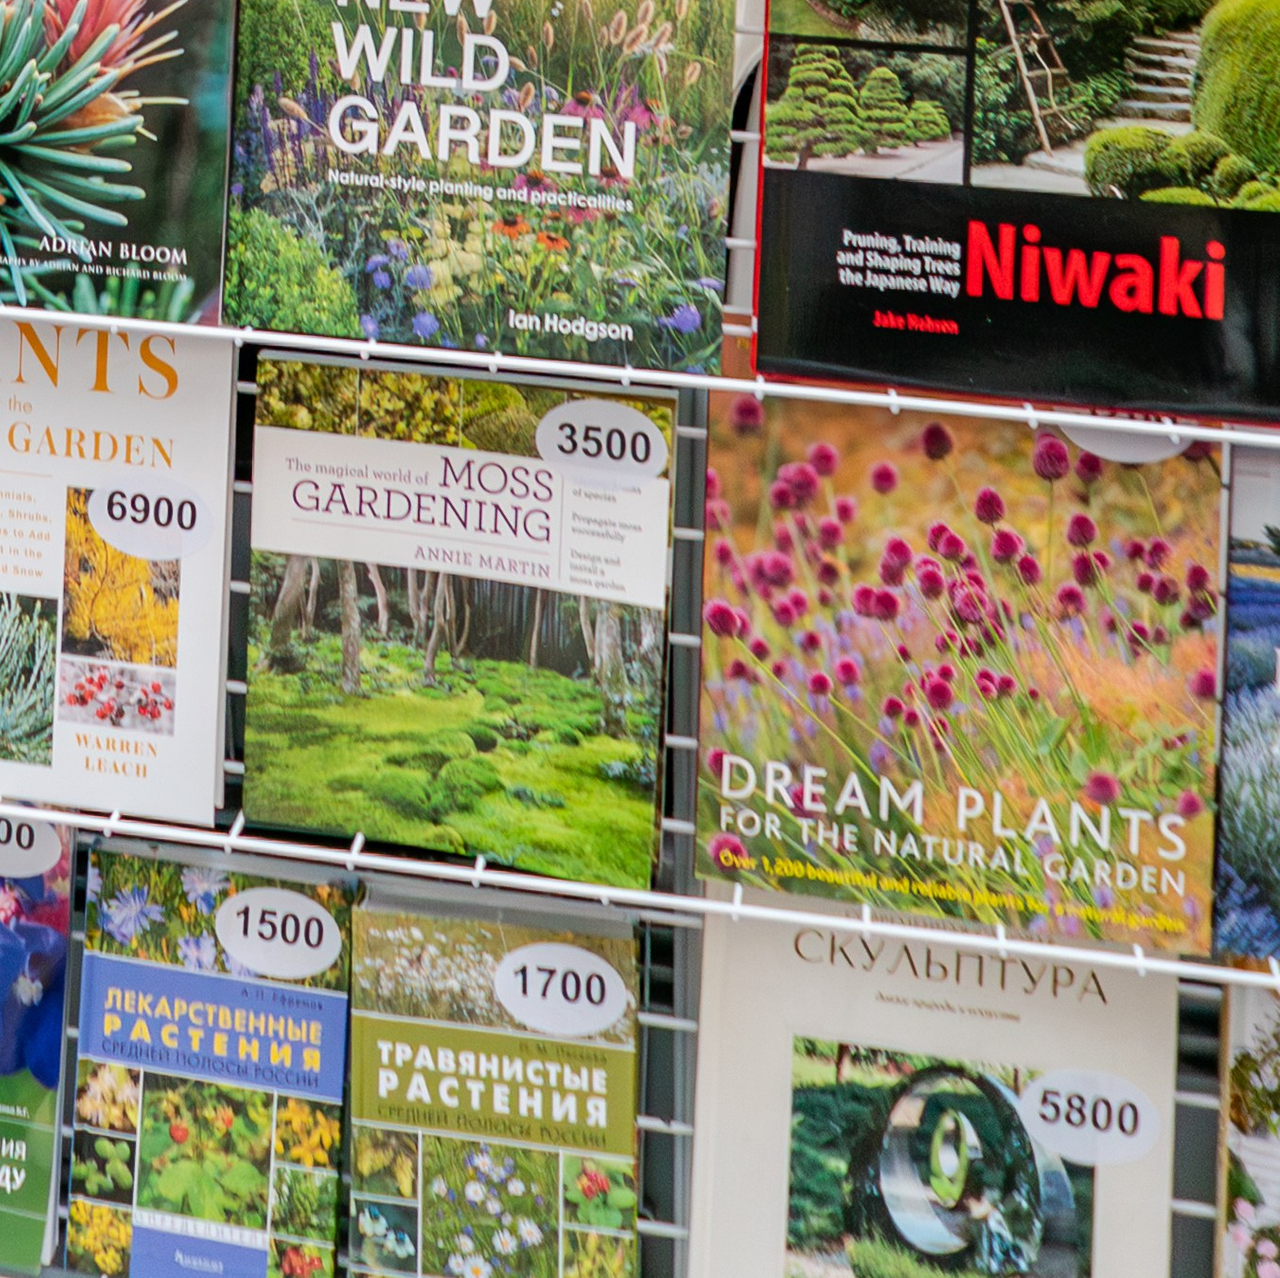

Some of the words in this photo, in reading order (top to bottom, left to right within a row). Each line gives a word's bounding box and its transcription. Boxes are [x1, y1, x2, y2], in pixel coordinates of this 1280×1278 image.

[331, 22, 509, 92] WILD
[328, 94, 636, 179] GARDEN
[966, 220, 1225, 320] Niwaki
[8, 421, 174, 468] GARDEN
[557, 423, 651, 463] 3500
[286, 458, 312, 472] The
[316, 461, 369, 480] magical
[373, 467, 411, 483] world
[415, 472, 429, 486] of
[439, 457, 554, 503] MOSS
[107, 491, 198, 530] 6900
[292, 481, 552, 543] GARDENING
[720, 754, 923, 825] DREAM
[956, 788, 1186, 860] PLANTS
[236, 906, 324, 949] 1500
[513, 966, 607, 1006] 1700
[103, 1014, 322, 1073] РАСТЕНИЯ
[104, 988, 322, 1044] ЛЕКАРСТВЕННЫЕ
[377, 1041, 608, 1096] ТРАВЯНИСТЫЕ
[378, 1066, 608, 1128] РАСТЕНИЯ
[1039, 1089, 1139, 1136] 5800
